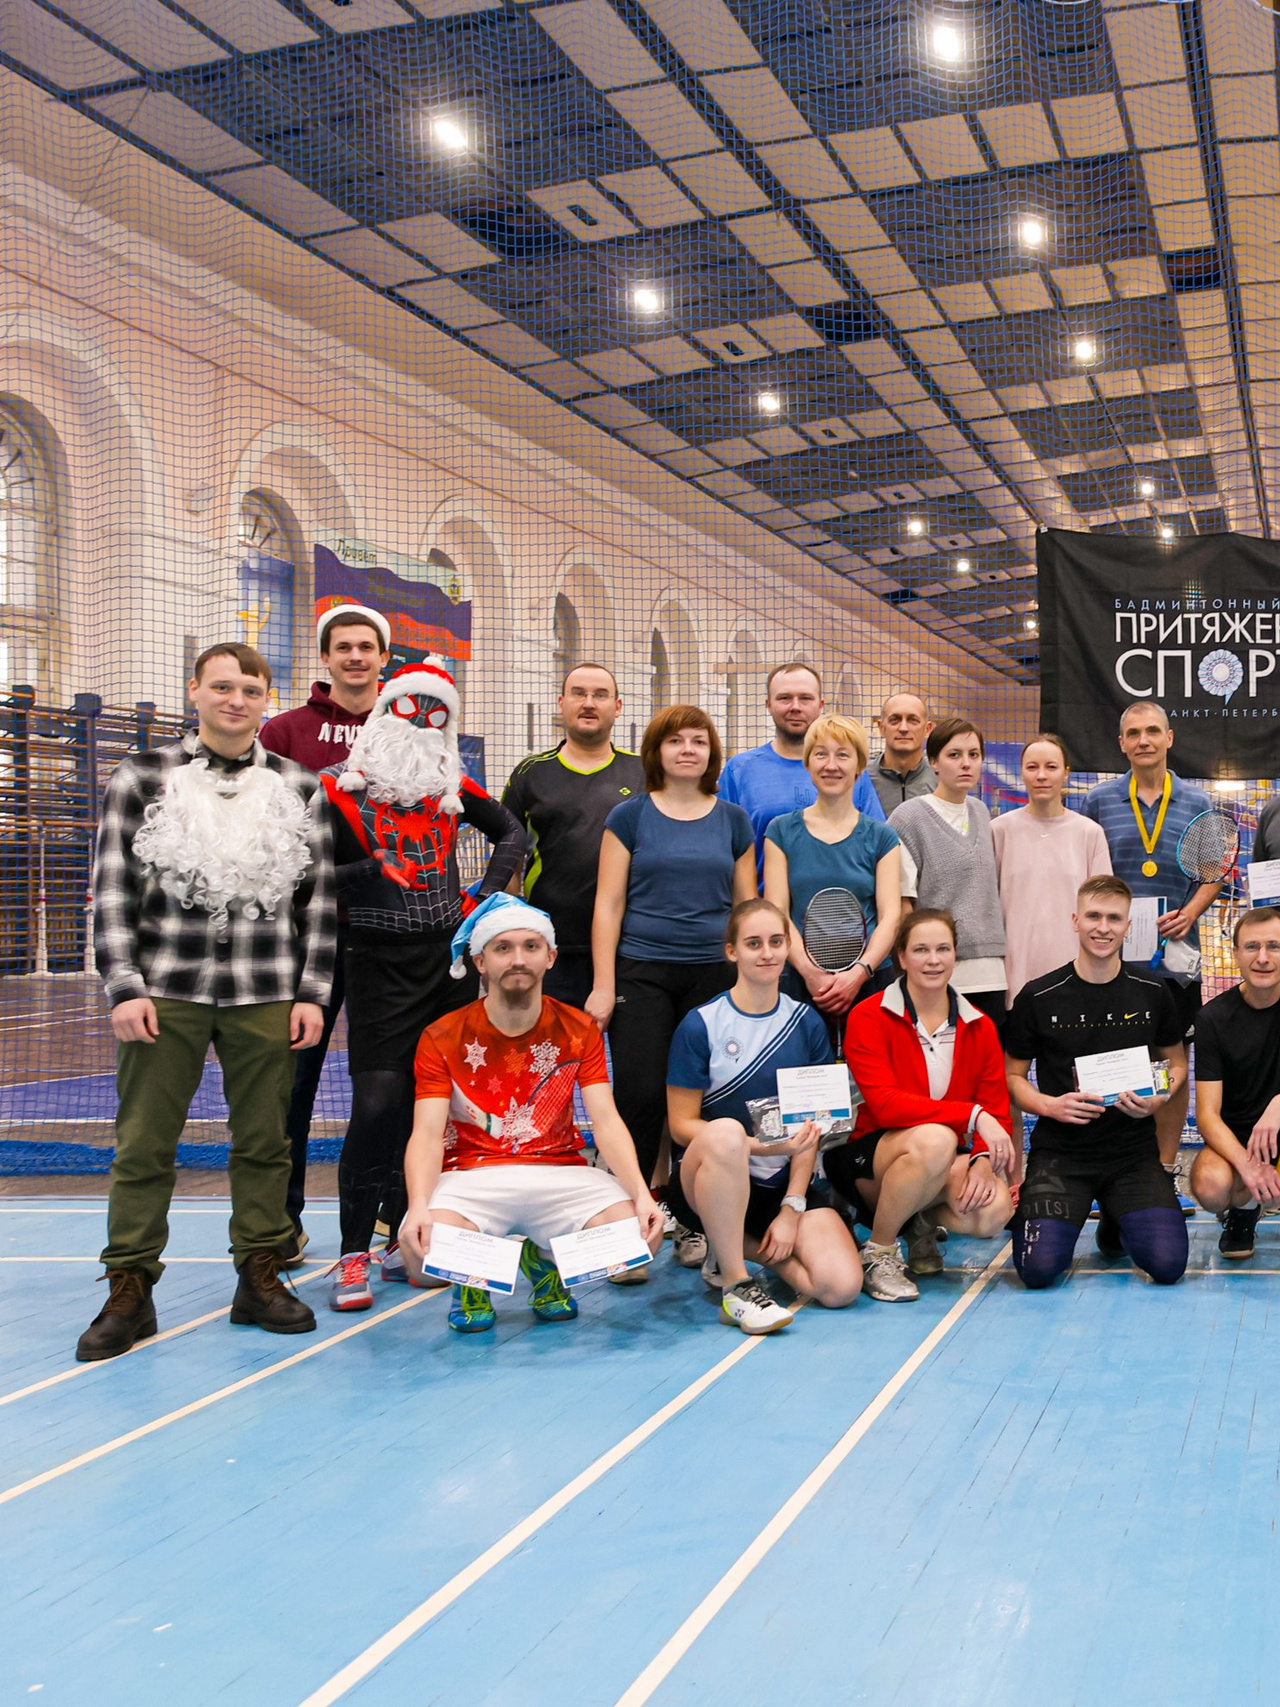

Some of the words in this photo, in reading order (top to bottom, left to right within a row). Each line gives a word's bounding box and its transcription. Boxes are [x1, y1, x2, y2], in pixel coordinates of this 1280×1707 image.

[336, 538, 378, 566] Привет
[1115, 598, 1280, 611] БАДМИНТОННЫЙ
[1051, 1011, 1151, 1023] NIKE
